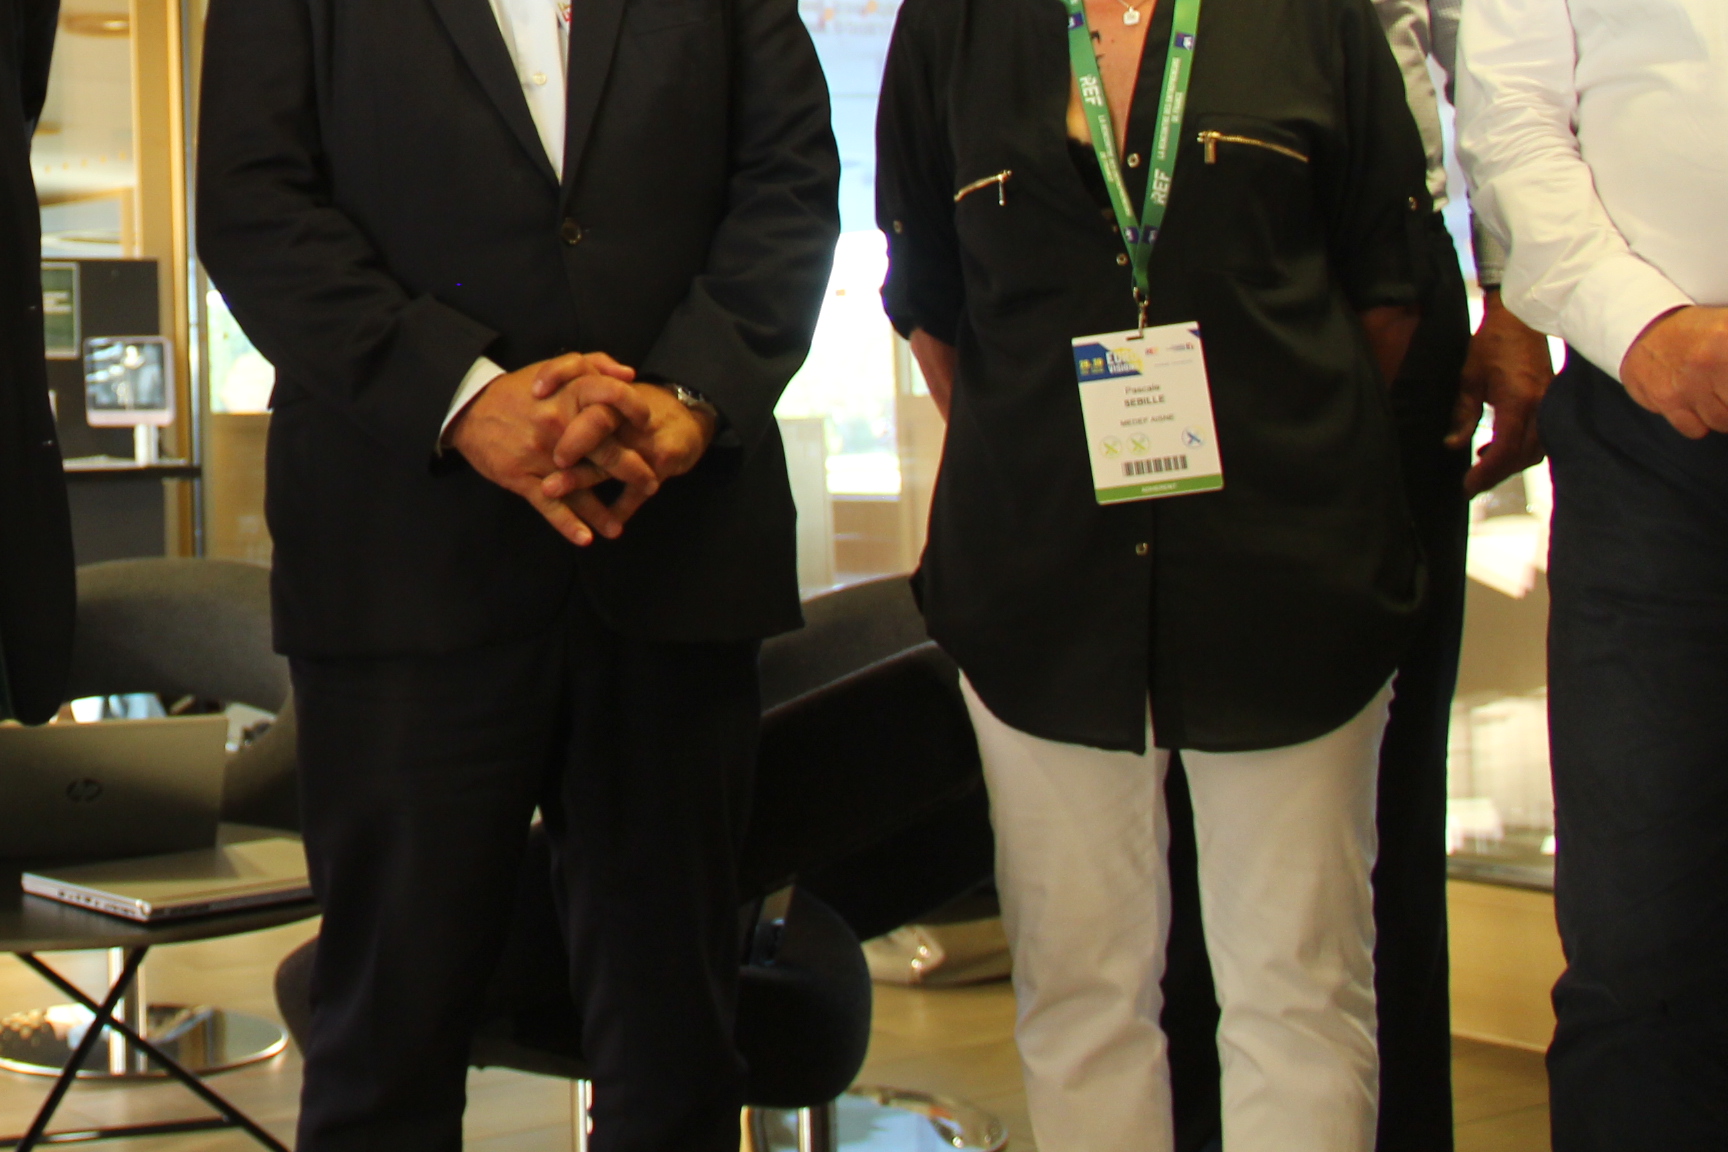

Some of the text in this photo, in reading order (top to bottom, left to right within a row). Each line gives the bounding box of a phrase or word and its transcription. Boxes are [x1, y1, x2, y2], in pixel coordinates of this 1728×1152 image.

[1079, 74, 1104, 107] REF
[1151, 168, 1172, 206] REF
[1124, 394, 1165, 407] SEBILLE
